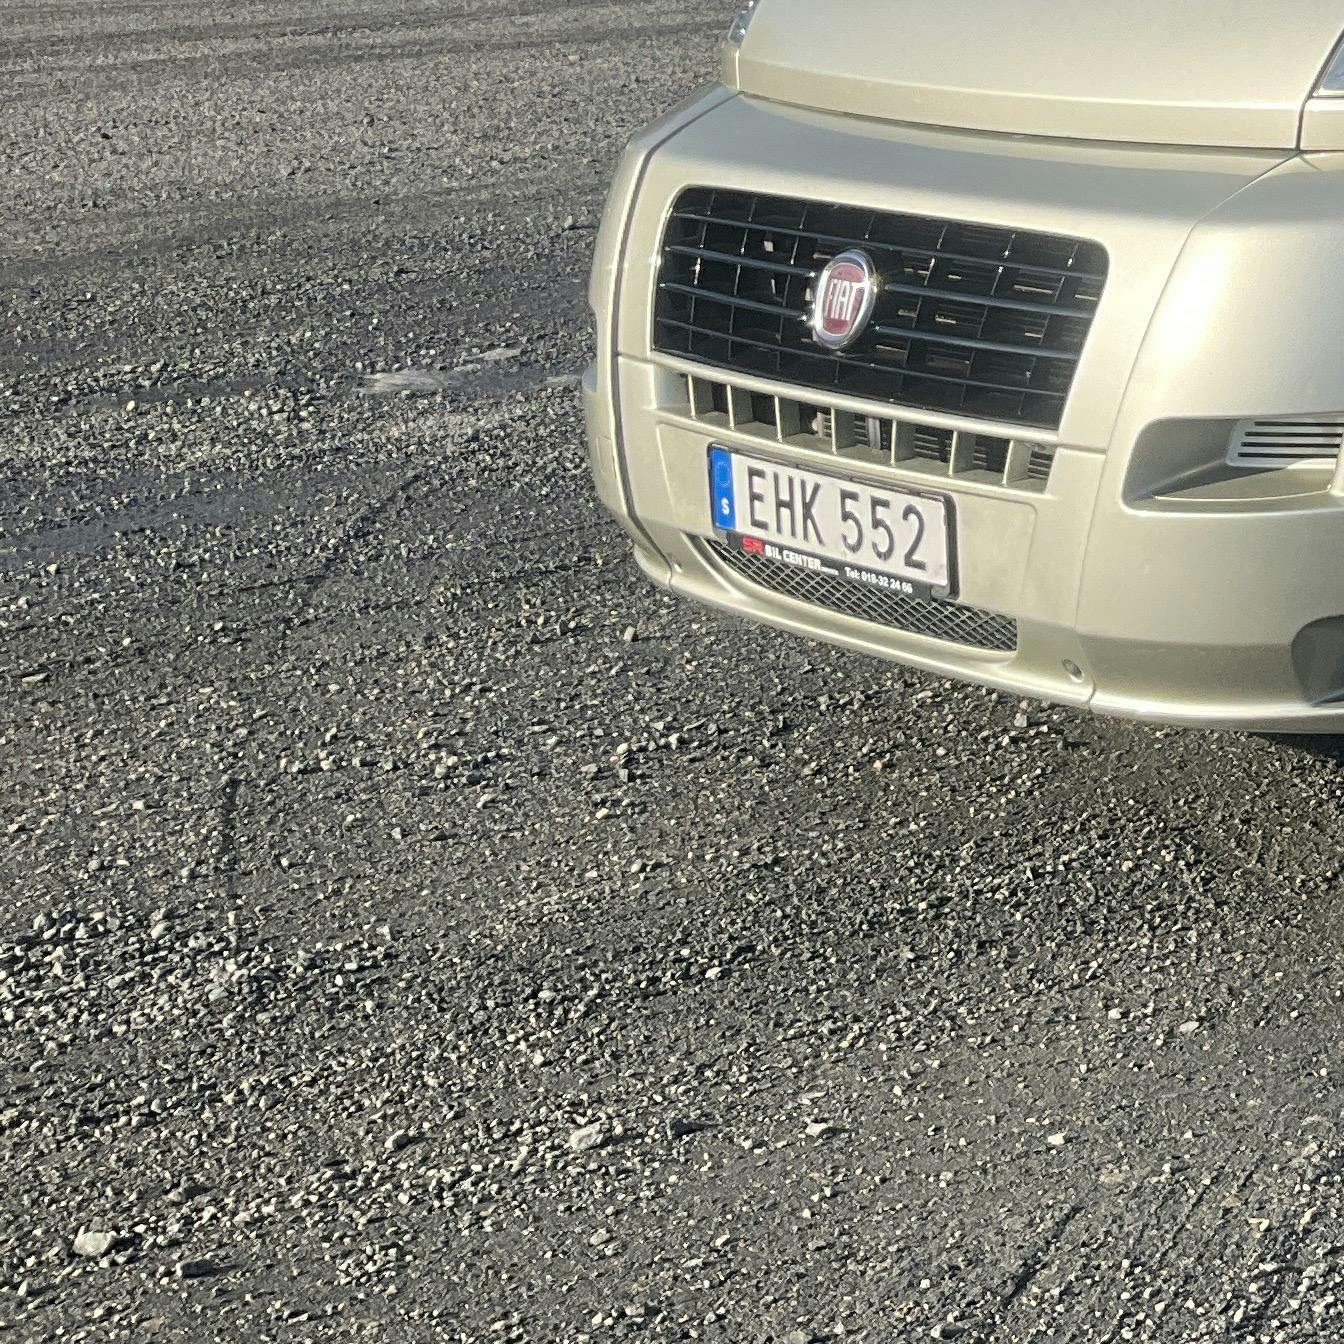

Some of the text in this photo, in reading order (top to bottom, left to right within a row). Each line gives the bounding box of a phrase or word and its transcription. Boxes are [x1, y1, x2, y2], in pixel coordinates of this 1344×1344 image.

[824, 278, 866, 321] FIAT
[721, 497, 730, 516] S
[747, 464, 928, 571] EHK 552
[765, 544, 782, 560] BIL
[782, 549, 822, 570] CENTER
